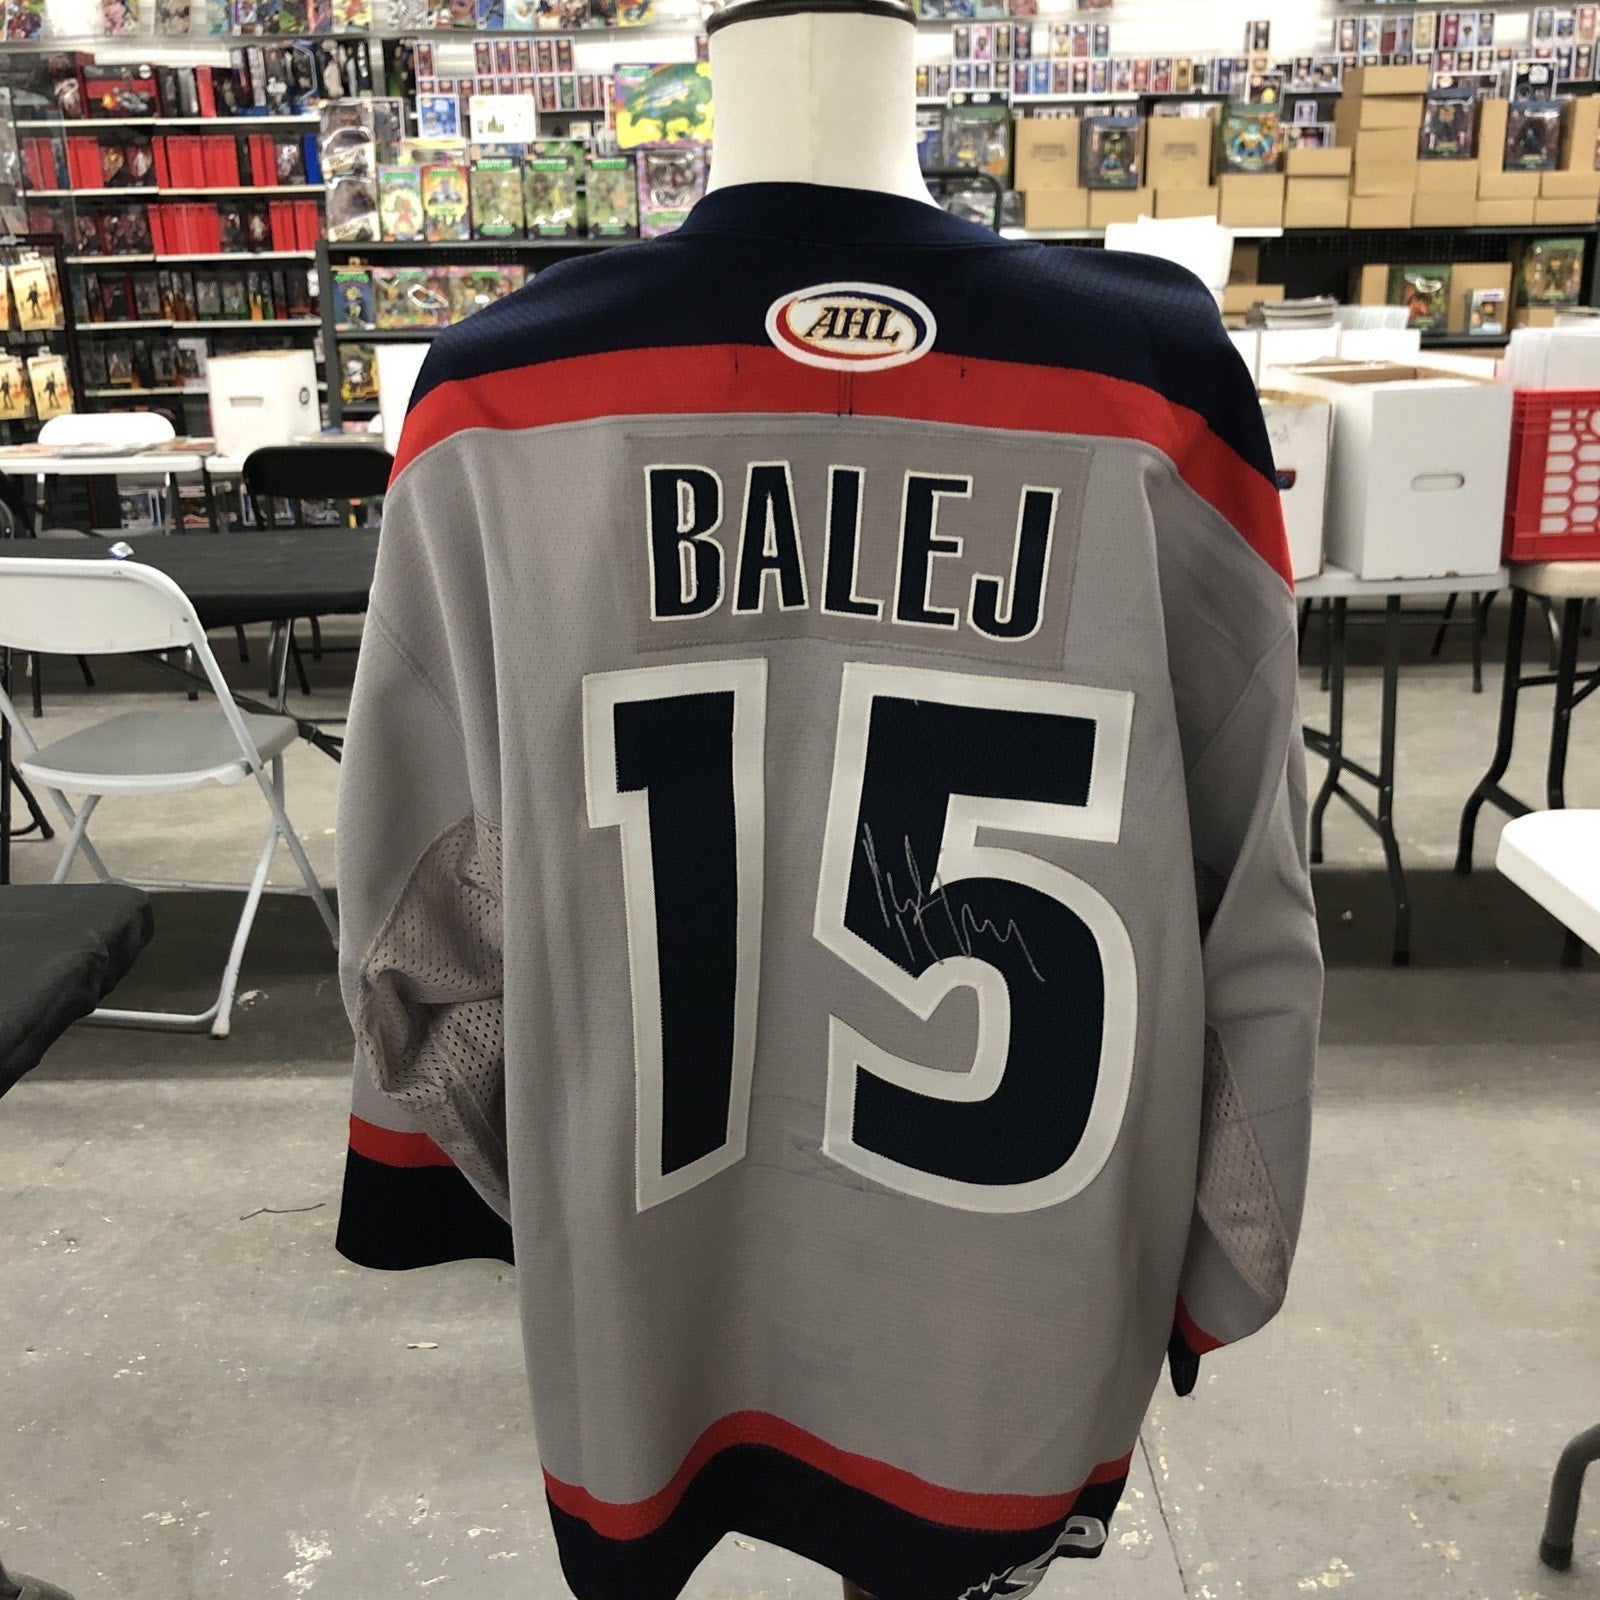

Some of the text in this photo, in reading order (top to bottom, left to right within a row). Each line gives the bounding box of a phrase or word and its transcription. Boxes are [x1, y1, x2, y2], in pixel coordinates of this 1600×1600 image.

[804, 306, 901, 345] AHL
[643, 460, 1062, 643] BALEJ
[581, 657, 1139, 1215] 15
